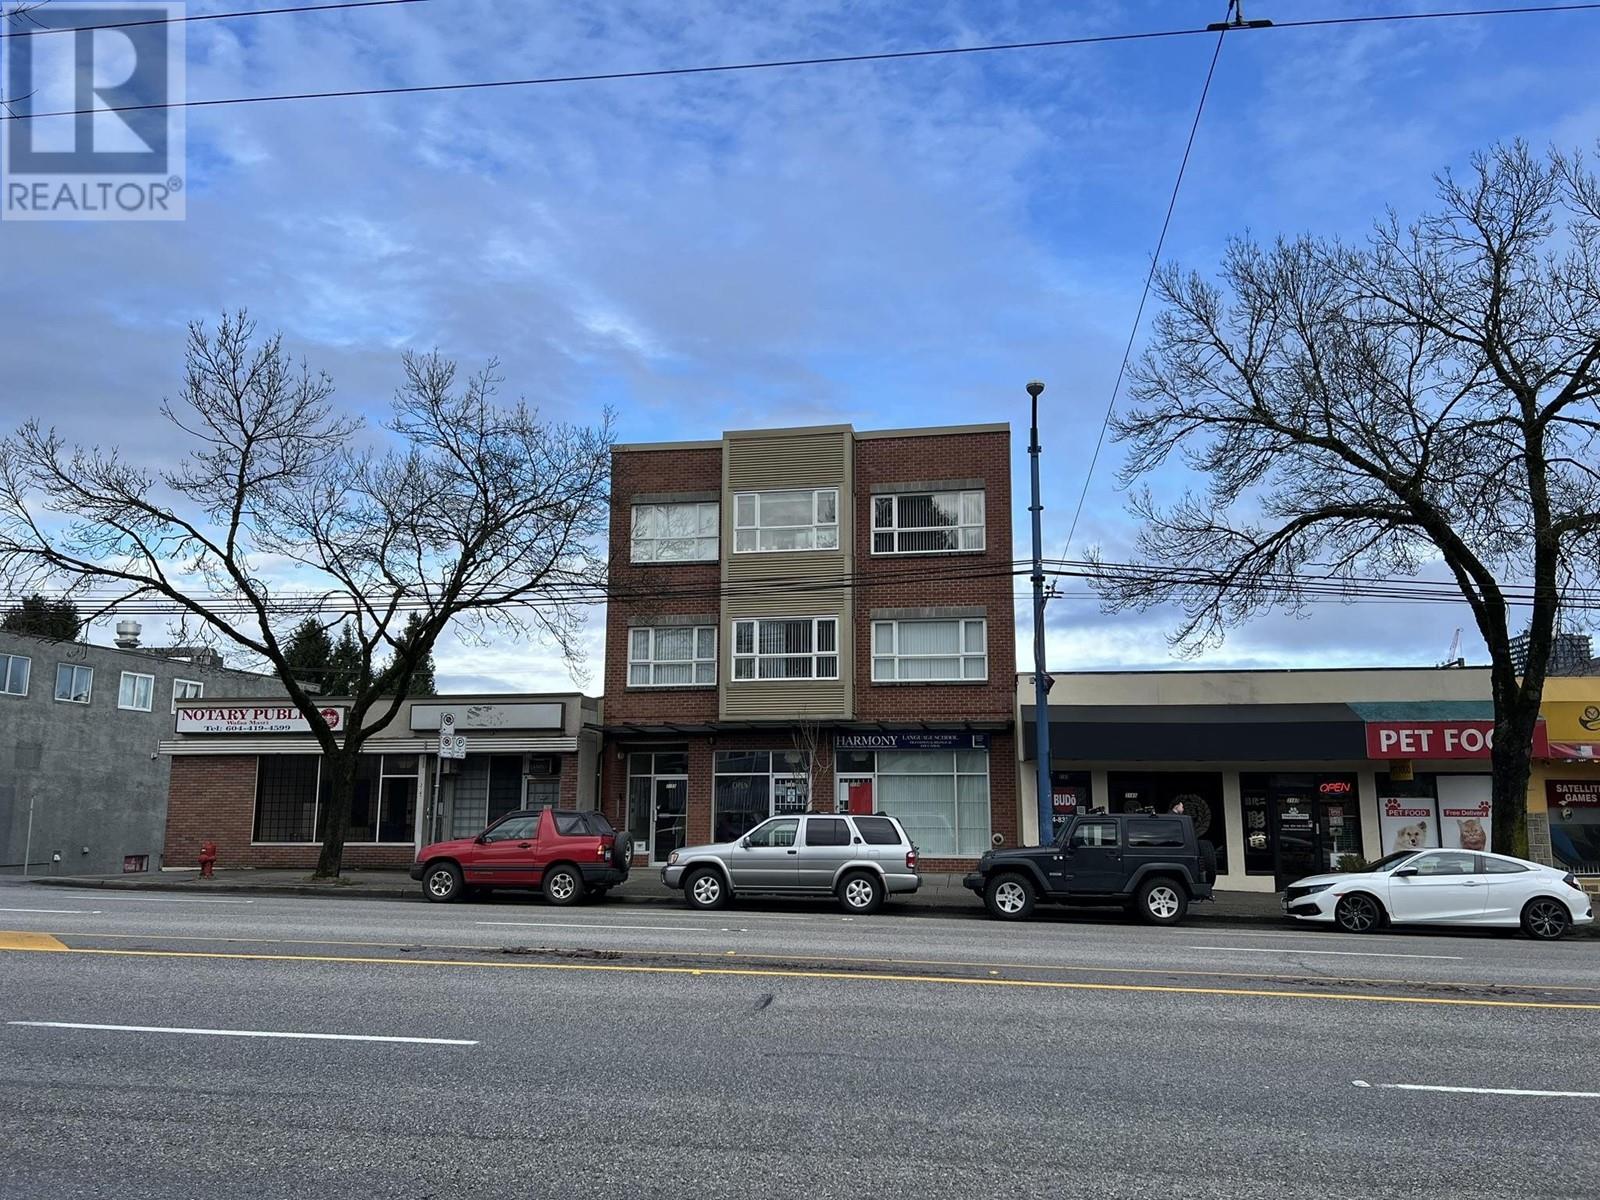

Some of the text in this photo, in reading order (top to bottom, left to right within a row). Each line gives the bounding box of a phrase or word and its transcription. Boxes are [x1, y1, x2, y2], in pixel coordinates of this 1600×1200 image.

[181, 708, 304, 721] NOTARY PUBLI
[836, 735, 898, 746] HARMONY
[1380, 729, 1433, 752] PET
[1320, 783, 1350, 792] OPEN
[1565, 794, 1598, 802] GAMES
[1461, 809, 1487, 817] Delivery
